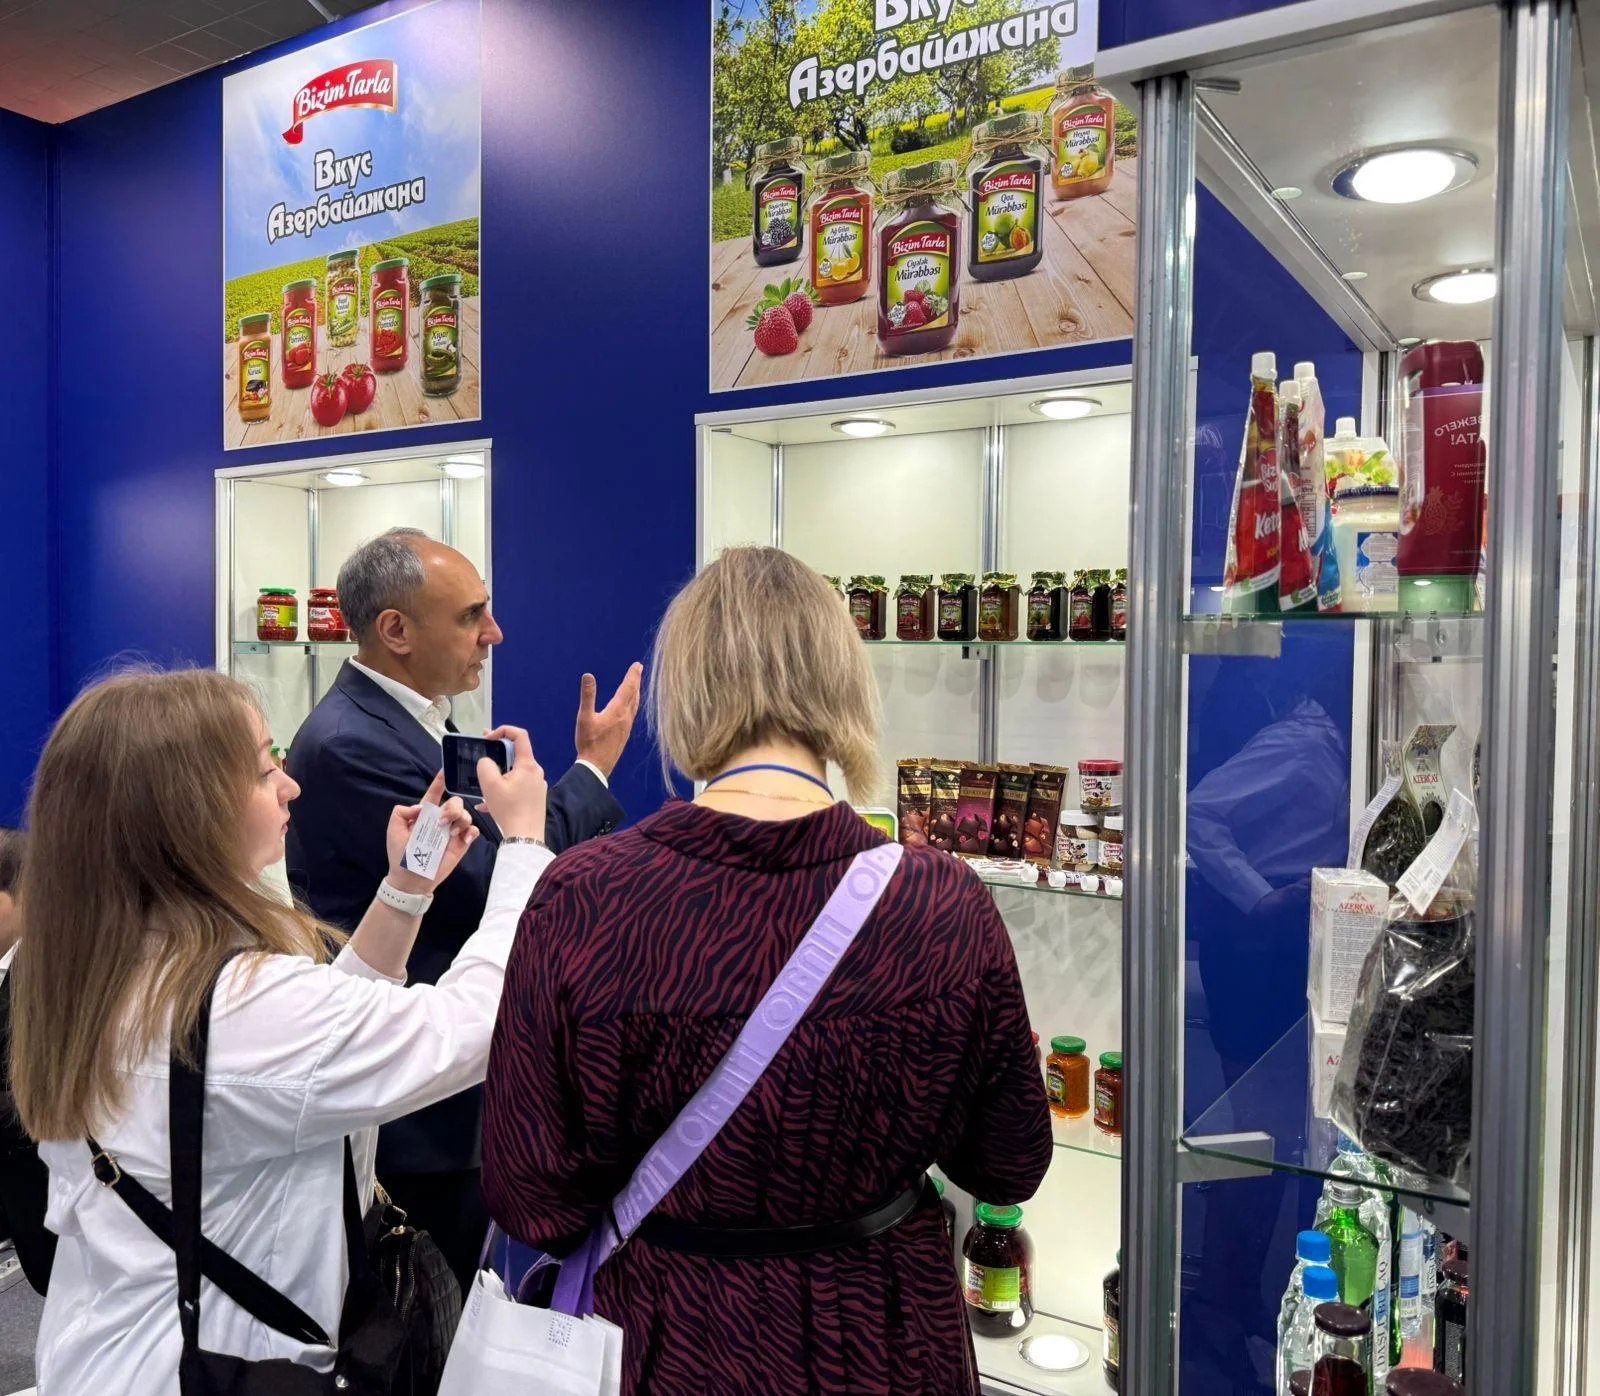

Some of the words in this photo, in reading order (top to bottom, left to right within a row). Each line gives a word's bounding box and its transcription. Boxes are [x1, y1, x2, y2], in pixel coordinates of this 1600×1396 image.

[788, 0, 1079, 110] Азербайджана
[296, 82, 346, 117] Bizim
[346, 68, 391, 98] Tarla
[1062, 119, 1084, 130] Bizim
[1084, 114, 1104, 124] Tarla
[314, 148, 373, 191] Вкус
[983, 178, 1008, 191] Bizim
[1009, 174, 1031, 186] Tarla
[762, 190, 780, 200] Bizim
[780, 187, 795, 197] Tarla
[267, 176, 426, 245] Азербайджана
[820, 213, 841, 223] Bizim
[841, 208, 860, 219] Tarla
[892, 239, 920, 255] Bizim
[920, 234, 946, 249] Tarla
